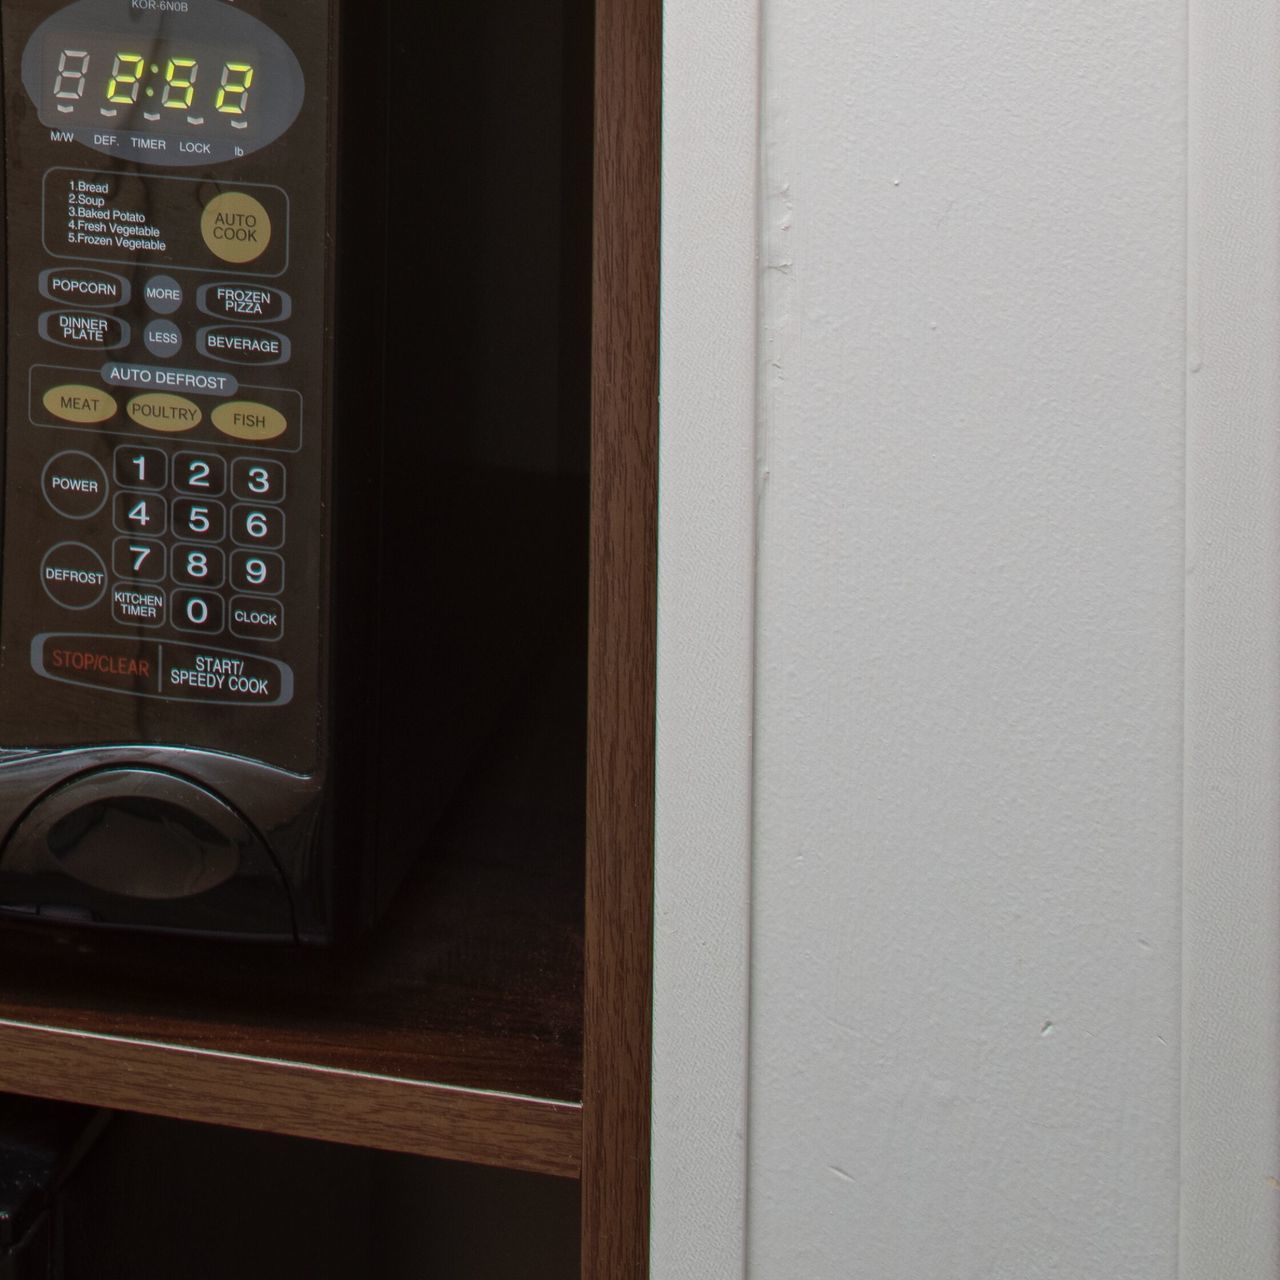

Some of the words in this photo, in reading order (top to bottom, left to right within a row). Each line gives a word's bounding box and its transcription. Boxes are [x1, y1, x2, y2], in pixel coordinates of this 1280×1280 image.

[50, 131, 74, 143] M/W
[93, 134, 120, 147] DEF.
[130, 137, 167, 151] TIMER
[179, 141, 211, 154] LOCK
[69, 181, 109, 194] 1.Bread
[68, 194, 105, 208] 2.Soup
[68, 207, 110, 220] 3.Baked
[112, 210, 146, 223] Potato
[214, 213, 257, 227] AUTO
[68, 220, 107, 234] 4.Fresh
[110, 223, 160, 237] Vegetable
[213, 227, 258, 242] COOK
[68, 233, 113, 248] 5.Frozen
[115, 237, 166, 251] Vegetable
[52, 279, 117, 296] POPCORN
[146, 287, 180, 301] MORE
[217, 288, 271, 304] FROZEN
[225, 300, 262, 314] PIZZA
[59, 316, 108, 331] DINNER
[63, 328, 104, 342] PLATE
[148, 332, 178, 344] LESS
[207, 335, 279, 353] BEVERAGE
[110, 367, 152, 383] AUTO
[155, 371, 227, 390] DEFROST
[60, 396, 100, 412] MEAT
[131, 403, 198, 422] POULTRY
[233, 413, 266, 428] FISH
[132, 456, 145, 481] 1
[188, 462, 210, 487] 2
[52, 477, 98, 493] POWER
[247, 468, 270, 493] 3
[128, 501, 150, 526] 4
[188, 507, 210, 532] 5
[245, 512, 268, 537] 6
[129, 546, 151, 571] 7
[186, 552, 208, 577] 8
[45, 567, 104, 585] DEFROST
[245, 559, 267, 584] 9
[114, 592, 163, 607] KITCHEN
[121, 604, 157, 618] TIMER
[186, 599, 208, 624] 0
[234, 611, 278, 626] CLOCK
[52, 650, 150, 677] STOP/CLEAR
[195, 655, 244, 675] START/
[170, 670, 225, 691] SPEEDY
[228, 677, 269, 695] COOK
